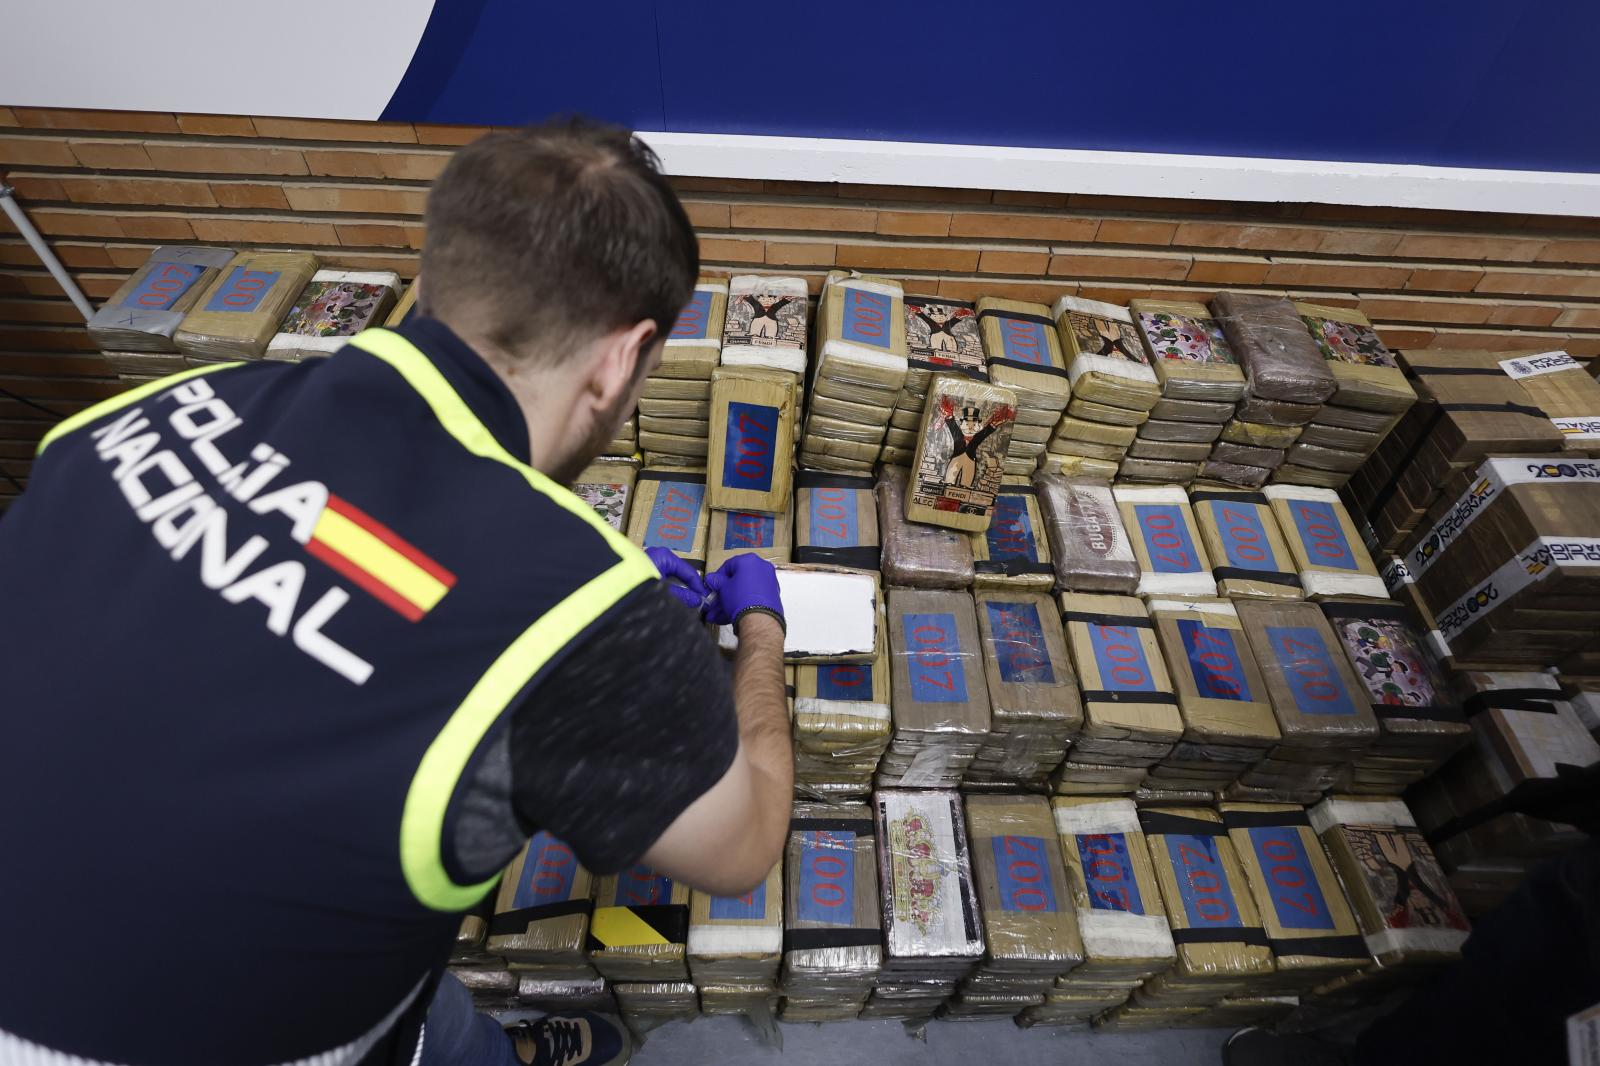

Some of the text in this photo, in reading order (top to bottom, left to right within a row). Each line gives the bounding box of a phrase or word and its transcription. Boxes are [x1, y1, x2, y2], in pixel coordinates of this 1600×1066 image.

[138, 264, 194, 307] 007
[853, 291, 885, 337] 007
[671, 300, 704, 336] 00
[1007, 319, 1041, 365] 007
[734, 413, 770, 479] 007
[657, 487, 694, 541] 007
[816, 487, 848, 540] 007
[948, 491, 967, 499] FENDI
[1440, 488, 1496, 543] NACIONAL
[90, 406, 375, 686] NACIONAL
[1145, 514, 1191, 569] 007
[1222, 508, 1266, 561] 007
[1301, 507, 1346, 559] 007
[913, 625, 956, 691] 007
[1100, 625, 1147, 686] 007
[1192, 629, 1241, 696] 007
[1282, 637, 1340, 701] 007
[531, 833, 574, 896] 00
[812, 831, 848, 908] 007
[1003, 835, 1048, 912] 007
[1084, 833, 1131, 912] 007
[1180, 843, 1230, 922] 007
[1263, 839, 1319, 917] 007
